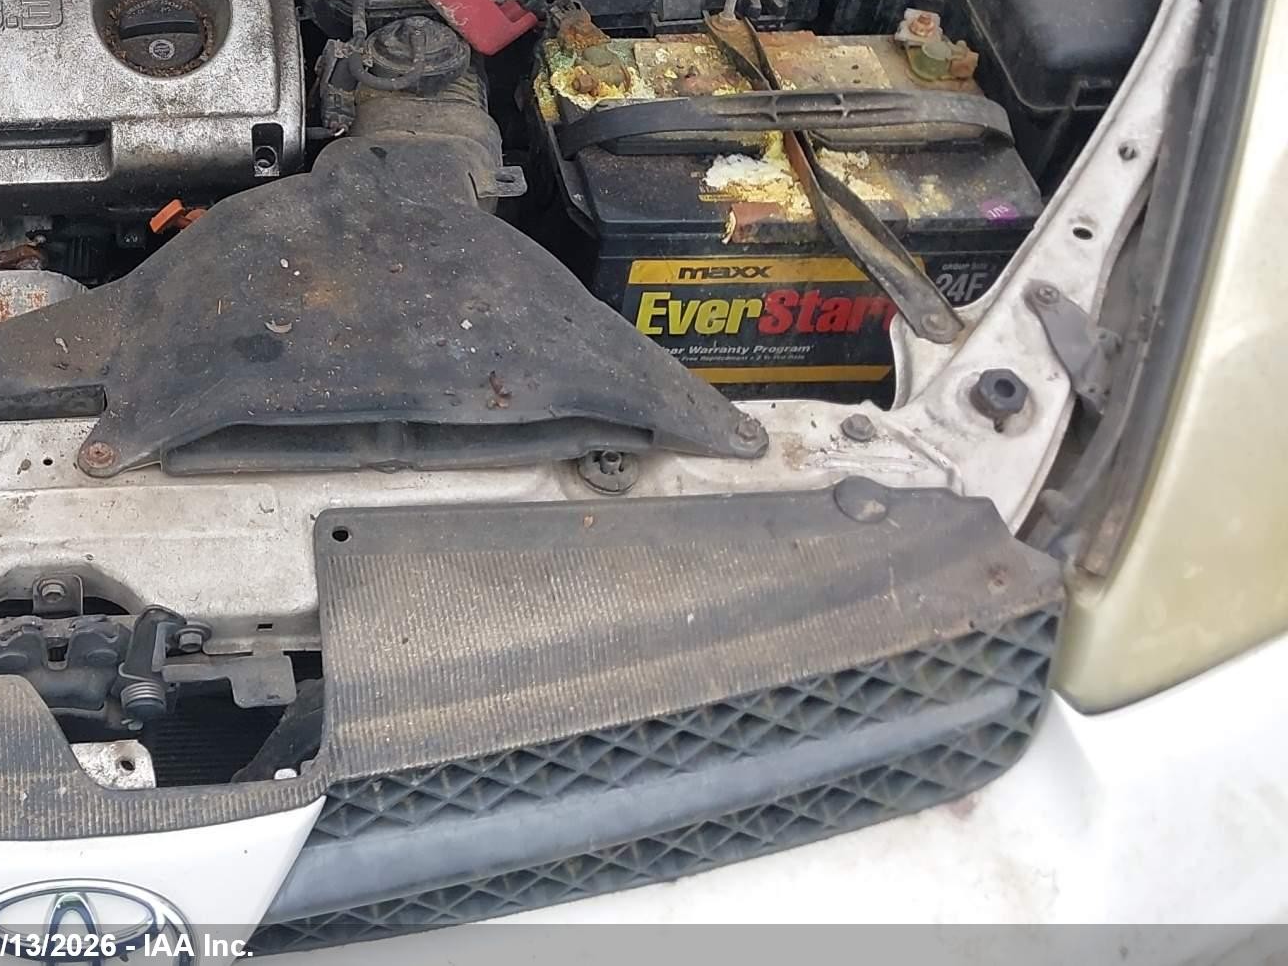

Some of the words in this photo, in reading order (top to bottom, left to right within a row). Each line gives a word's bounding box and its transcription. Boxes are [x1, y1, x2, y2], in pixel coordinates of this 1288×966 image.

[677, 264, 773, 280] maxx
[935, 272, 988, 302] 24F
[662, 347, 685, 355] ear
[688, 344, 750, 355] Warranty
